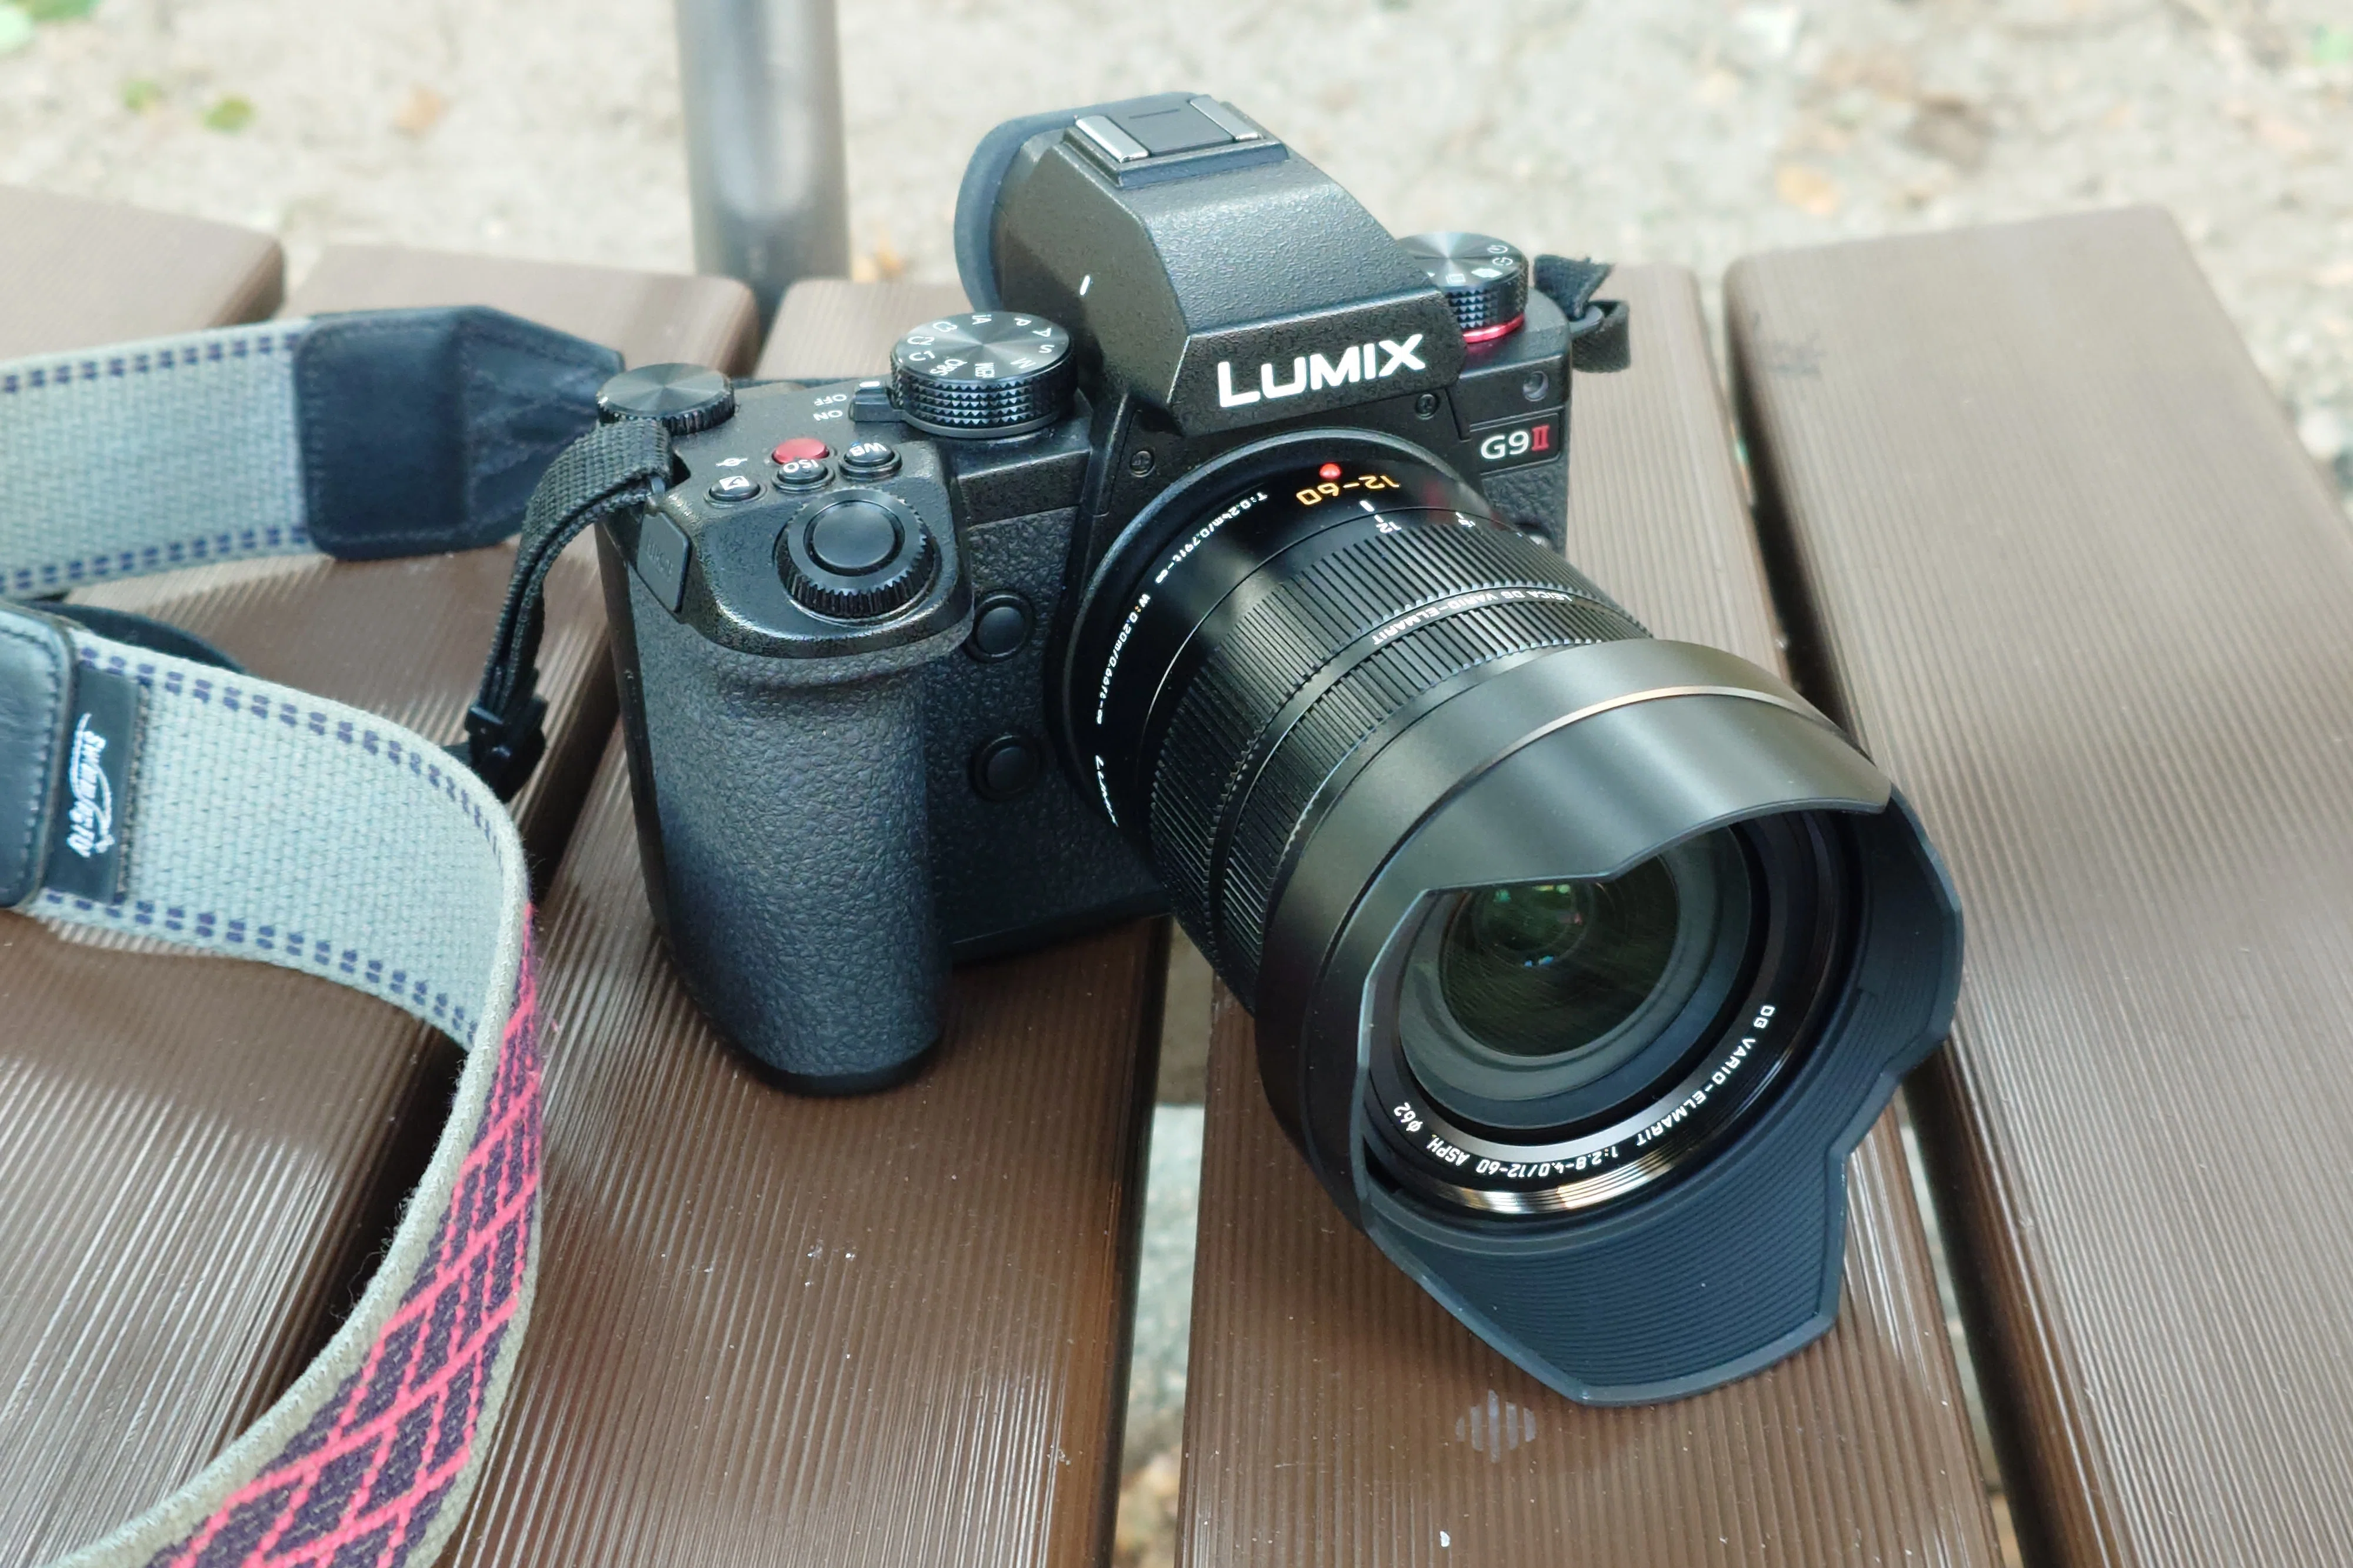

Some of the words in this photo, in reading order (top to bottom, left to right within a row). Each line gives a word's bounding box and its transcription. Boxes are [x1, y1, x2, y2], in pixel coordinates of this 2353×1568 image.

[972, 315, 992, 325] iA
[1014, 318, 1032, 327] P
[932, 321, 957, 333] C3
[1032, 328, 1052, 338] A
[907, 336, 935, 346] C2
[909, 350, 936, 361] C1
[1039, 345, 1055, 354] S
[930, 358, 967, 376] S&Q
[1010, 356, 1036, 369] M
[1217, 332, 1426, 408] LUMIX
[814, 393, 848, 406] OFF
[812, 409, 843, 422] ON
[848, 442, 886, 457] WB
[783, 458, 819, 473] ISO
[1296, 475, 1400, 506] 12-60
[1375, 522, 1402, 533] 12
[1502, 590, 1525, 600] DG
[1527, 589, 1573, 602] LEICA
[1371, 593, 1499, 646] VARIO-ELMARIT
[1752, 1005, 1775, 1030] DG
[1635, 1037, 1756, 1147] VARIO-ELMARIT
